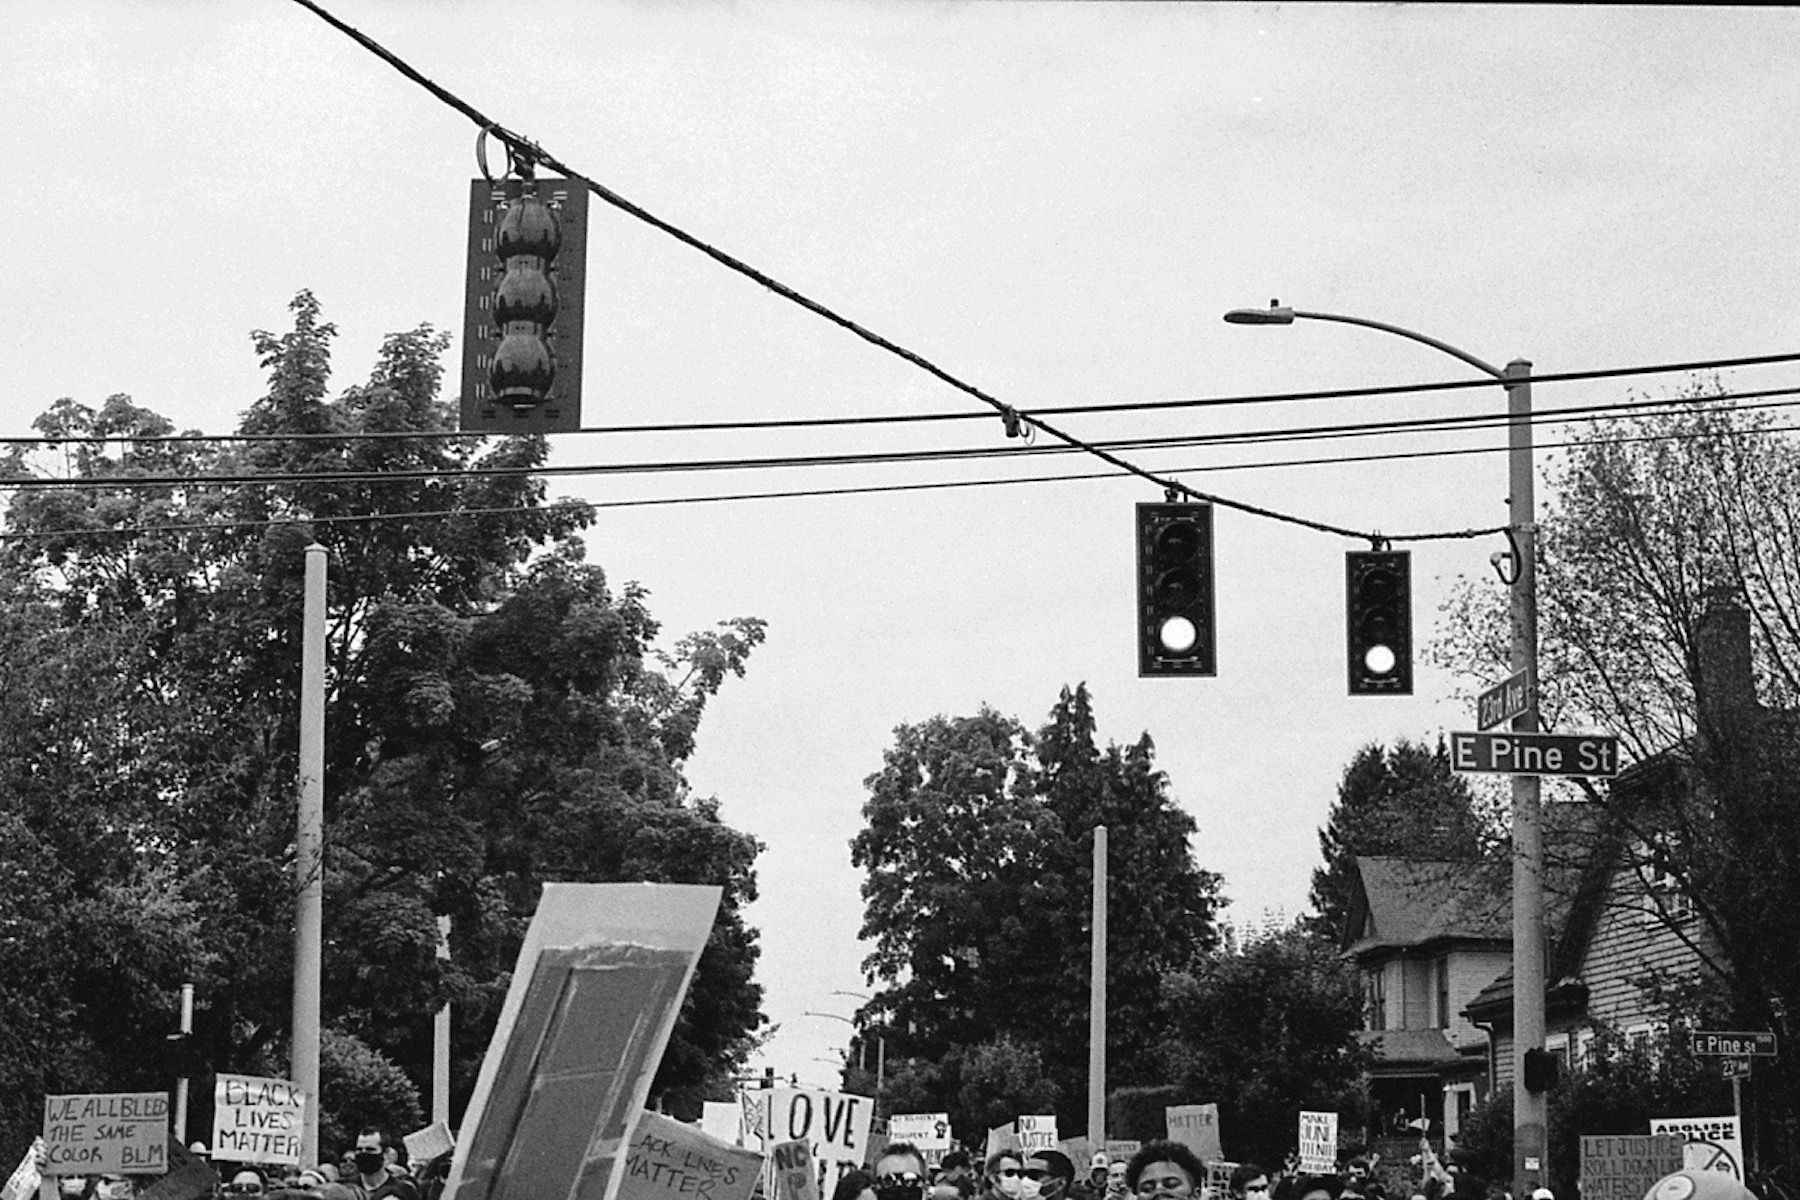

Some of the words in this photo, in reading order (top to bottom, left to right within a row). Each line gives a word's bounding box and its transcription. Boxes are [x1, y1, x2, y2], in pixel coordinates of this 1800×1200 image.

[1505, 683, 1524, 715] Ave
[1457, 737, 1477, 768] E
[1491, 738, 1563, 770] Pine
[1578, 740, 1611, 772] St
[1695, 1040, 1704, 1053] E
[1707, 1035, 1741, 1053] Pine
[1743, 1041, 1756, 1053] St
[226, 1079, 299, 1109] BLACK
[48, 1098, 81, 1122] WE
[81, 1098, 118, 1119] ALL
[235, 1108, 294, 1130] LIVES
[767, 1093, 860, 1150] LOVE
[1020, 1117, 1036, 1130] NO
[1656, 1123, 1733, 1132] ABOLISH
[48, 1124, 87, 1142] THE
[94, 1124, 136, 1141] SAME
[219, 1129, 299, 1157] MATTER
[49, 1144, 103, 1164] COLOR
[121, 1143, 164, 1165] BLM
[1583, 1138, 1612, 1157] LET
[1617, 1137, 1679, 1156] JUSTICE
[1583, 1160, 1622, 1176] ROLL
